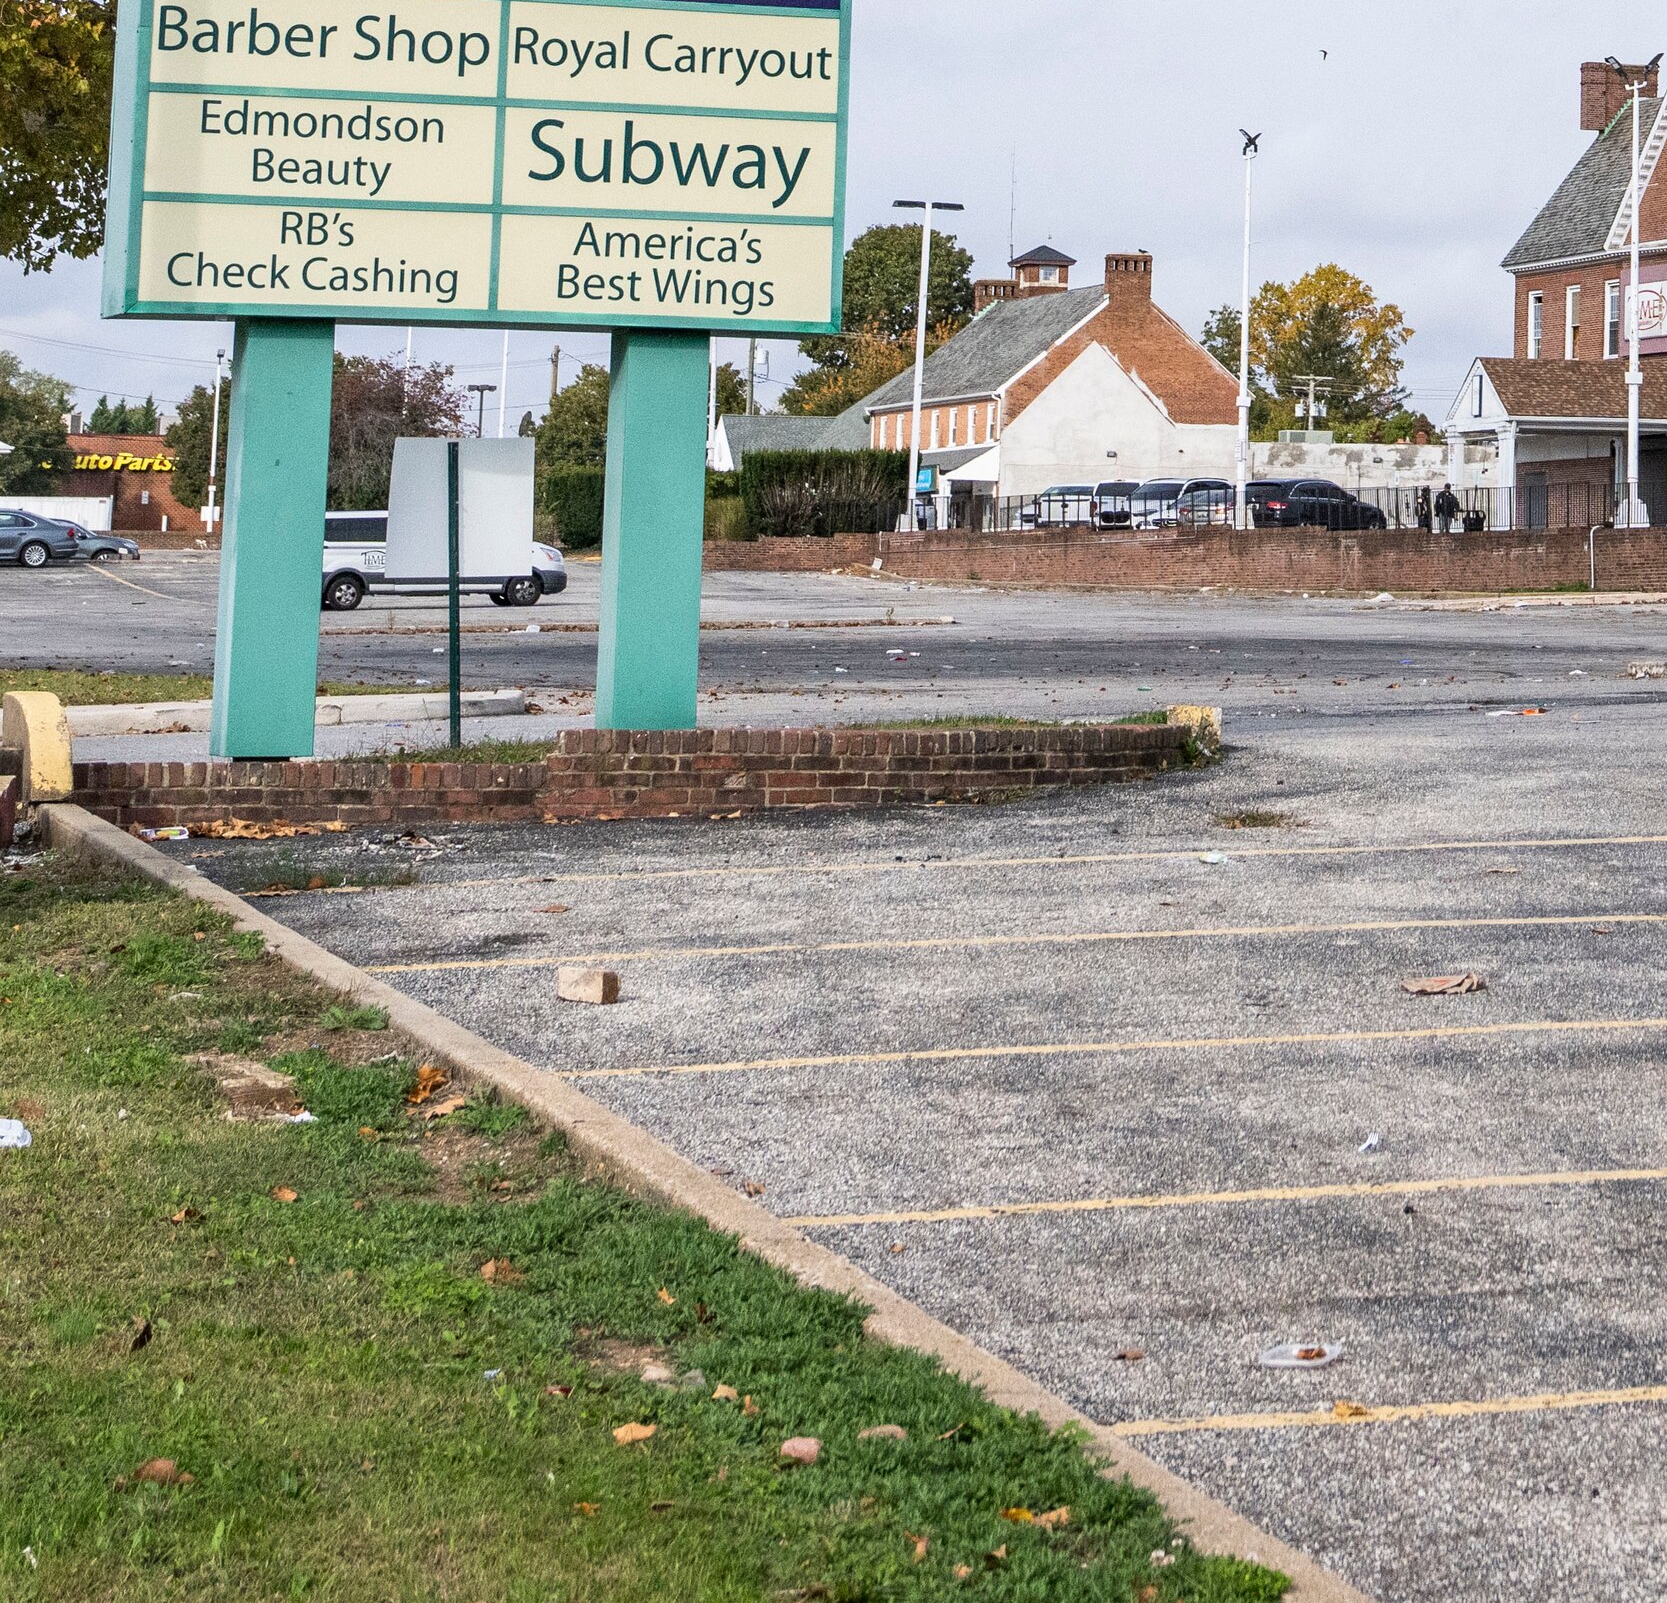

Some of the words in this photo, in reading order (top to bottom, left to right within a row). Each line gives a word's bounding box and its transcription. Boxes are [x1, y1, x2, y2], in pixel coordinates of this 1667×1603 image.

[157, 4, 338, 58] Barber
[353, 14, 491, 77] Shop
[513, 26, 630, 79] Royal
[644, 33, 833, 87] Carryout
[200, 98, 445, 143] Edmondson
[252, 147, 392, 197] Beauty
[527, 118, 812, 209] Subway
[280, 210, 354, 246] RB's
[573, 221, 763, 265] America's
[167, 251, 291, 289] Check
[301, 256, 459, 304] Cashing
[557, 263, 642, 302] Best
[652, 267, 775, 316] Wings
